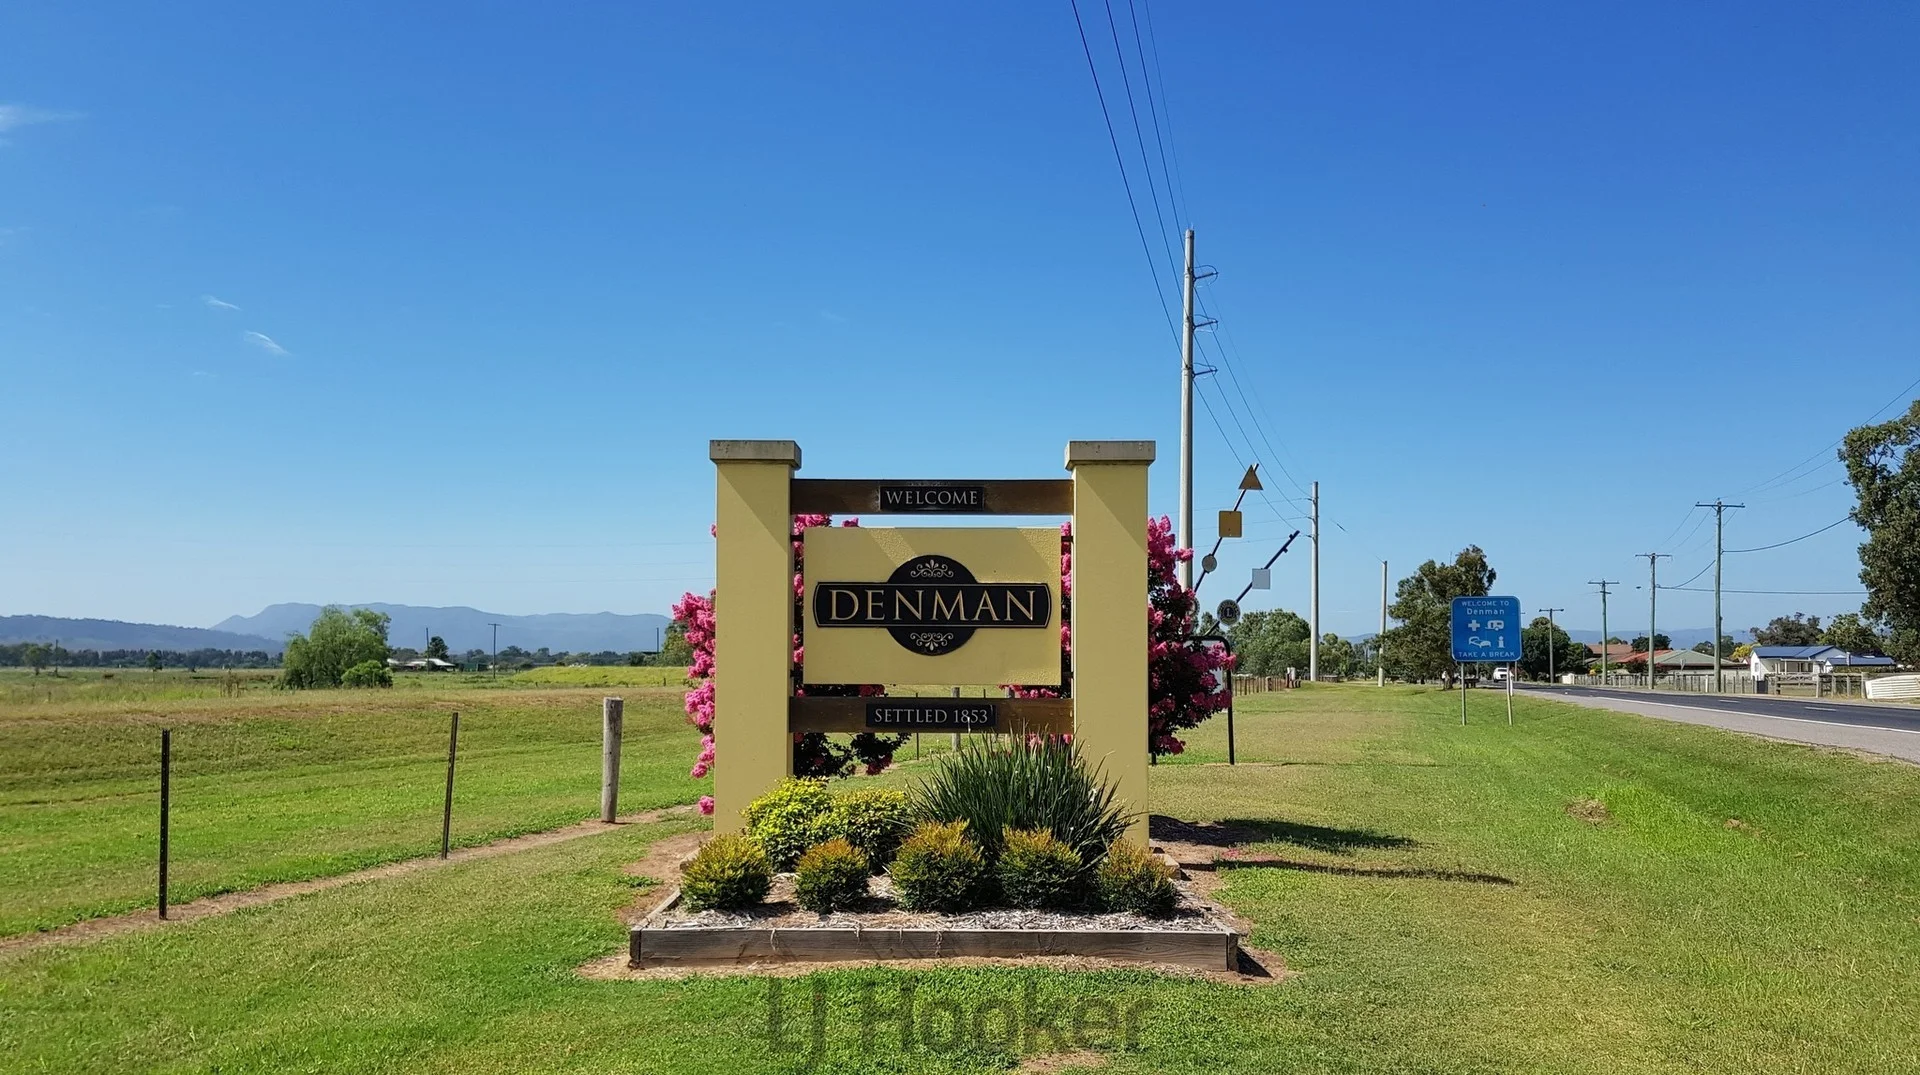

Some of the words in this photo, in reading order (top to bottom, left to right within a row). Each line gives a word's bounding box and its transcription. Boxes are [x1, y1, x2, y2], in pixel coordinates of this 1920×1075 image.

[886, 490, 978, 505] WELCOME
[829, 589, 1036, 622] DENMAN
[874, 708, 948, 724] SETTLED
[953, 708, 988, 724] 1853
